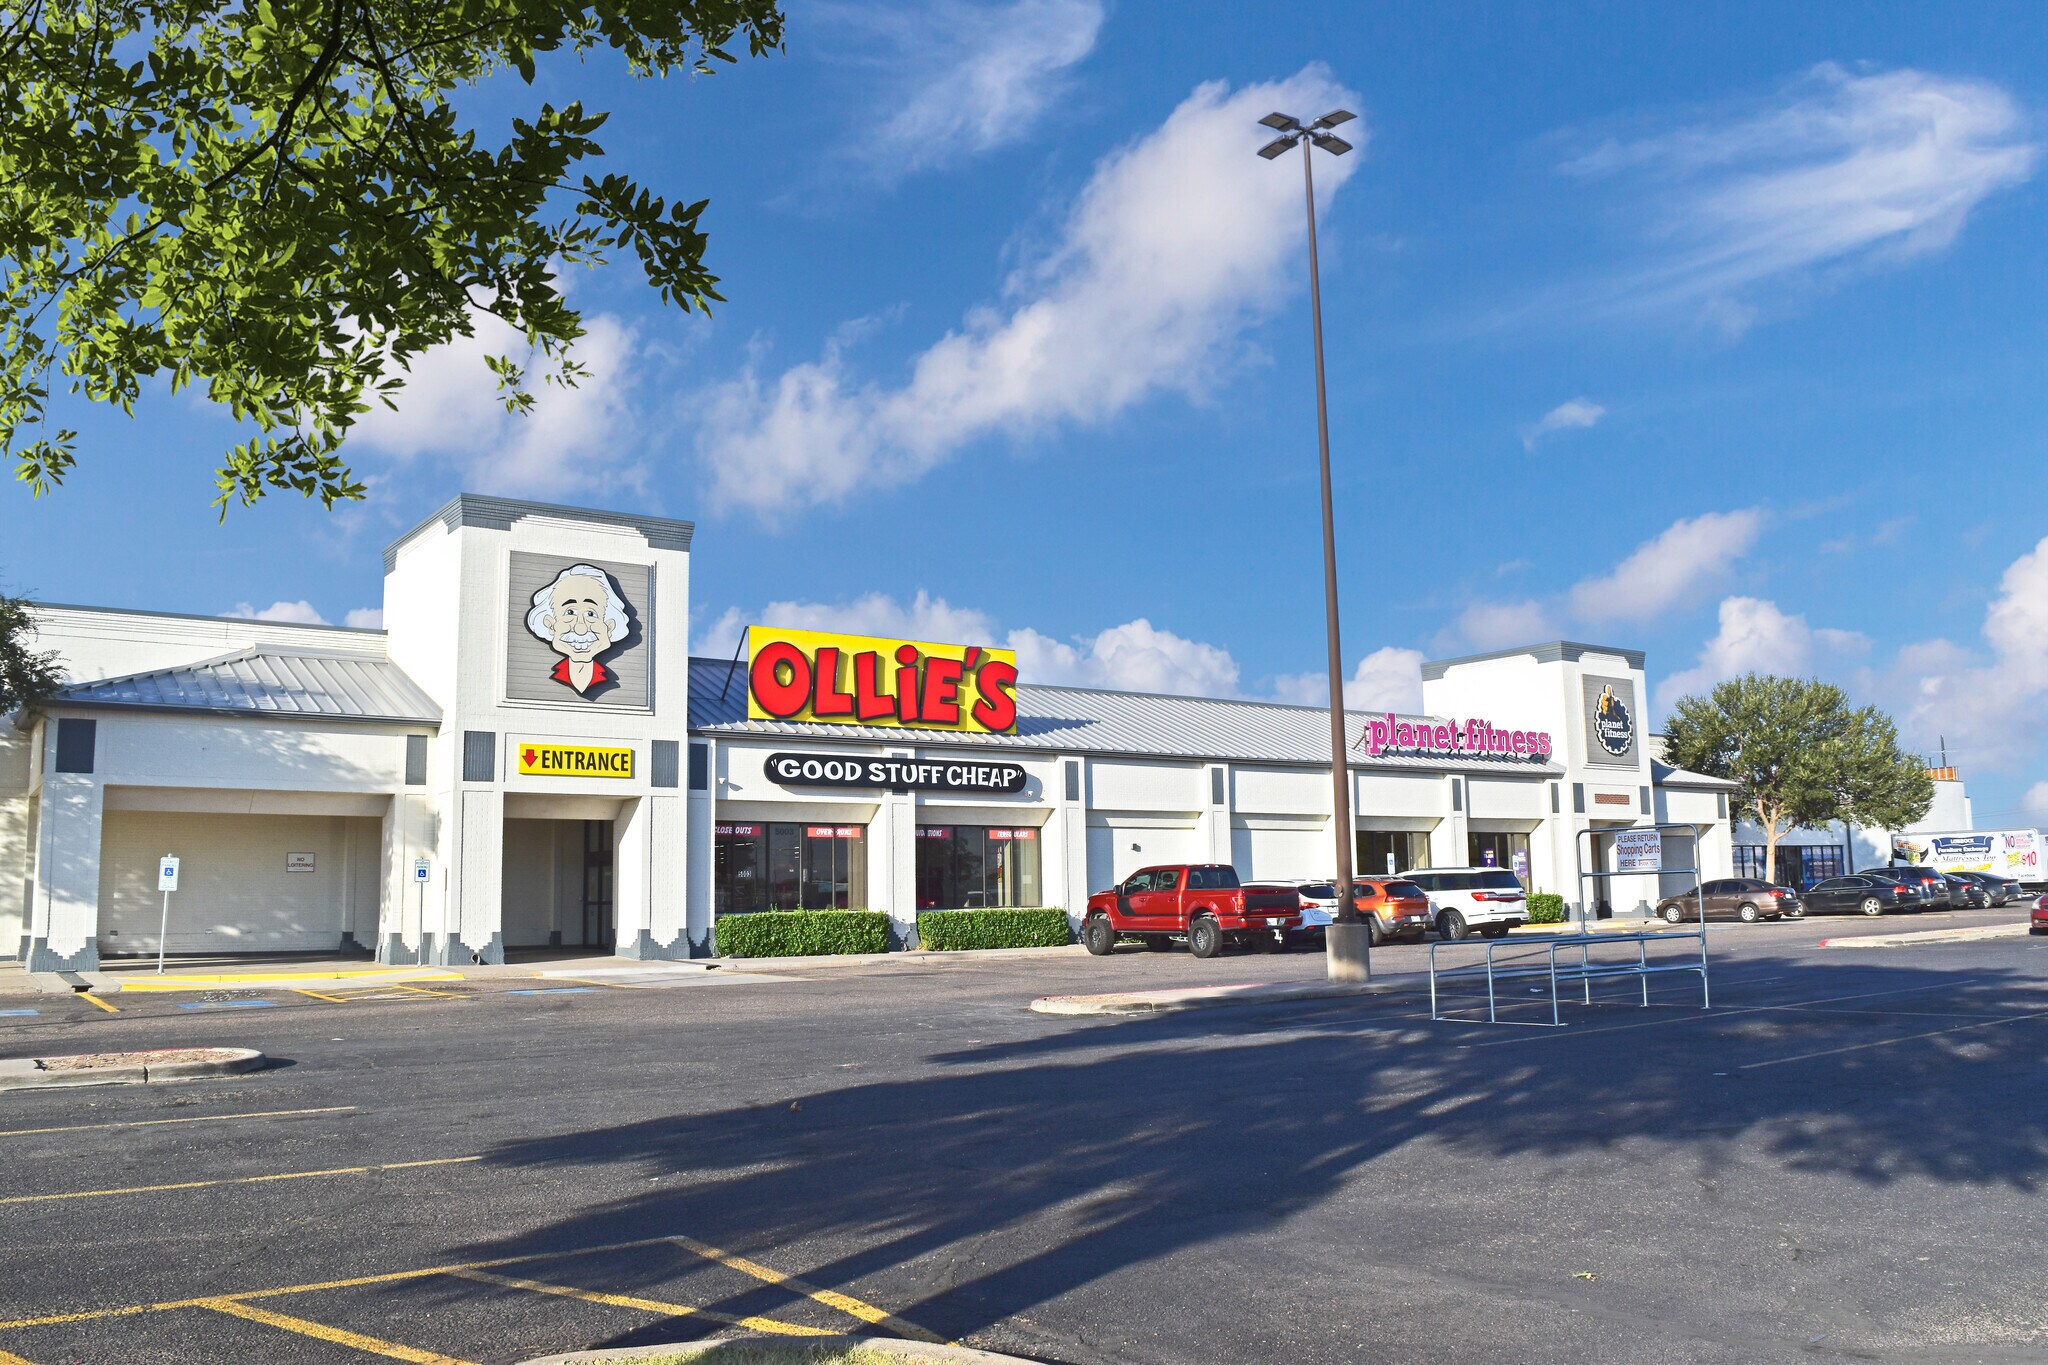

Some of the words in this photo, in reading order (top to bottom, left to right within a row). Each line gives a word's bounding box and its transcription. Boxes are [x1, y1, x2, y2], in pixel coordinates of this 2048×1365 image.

[1601, 719, 1623, 730] planet
[1368, 713, 1458, 755] planet
[1464, 718, 1551, 754] fitness
[1604, 728, 1628, 738] fitness
[541, 749, 629, 771] ENTRANCE
[868, 762, 944, 784] STUFF
[735, 826, 752, 834] OUTS
[775, 827, 794, 836] 5003
[1617, 834, 1636, 843] PLEASE
[1637, 834, 1658, 842] RETURN
[2005, 835, 2015, 848] NO
[1616, 843, 1643, 857] Shopping
[1643, 843, 1660, 854] Carts
[1620, 859, 1636, 867] HERE
[2021, 851, 2037, 866] $10
